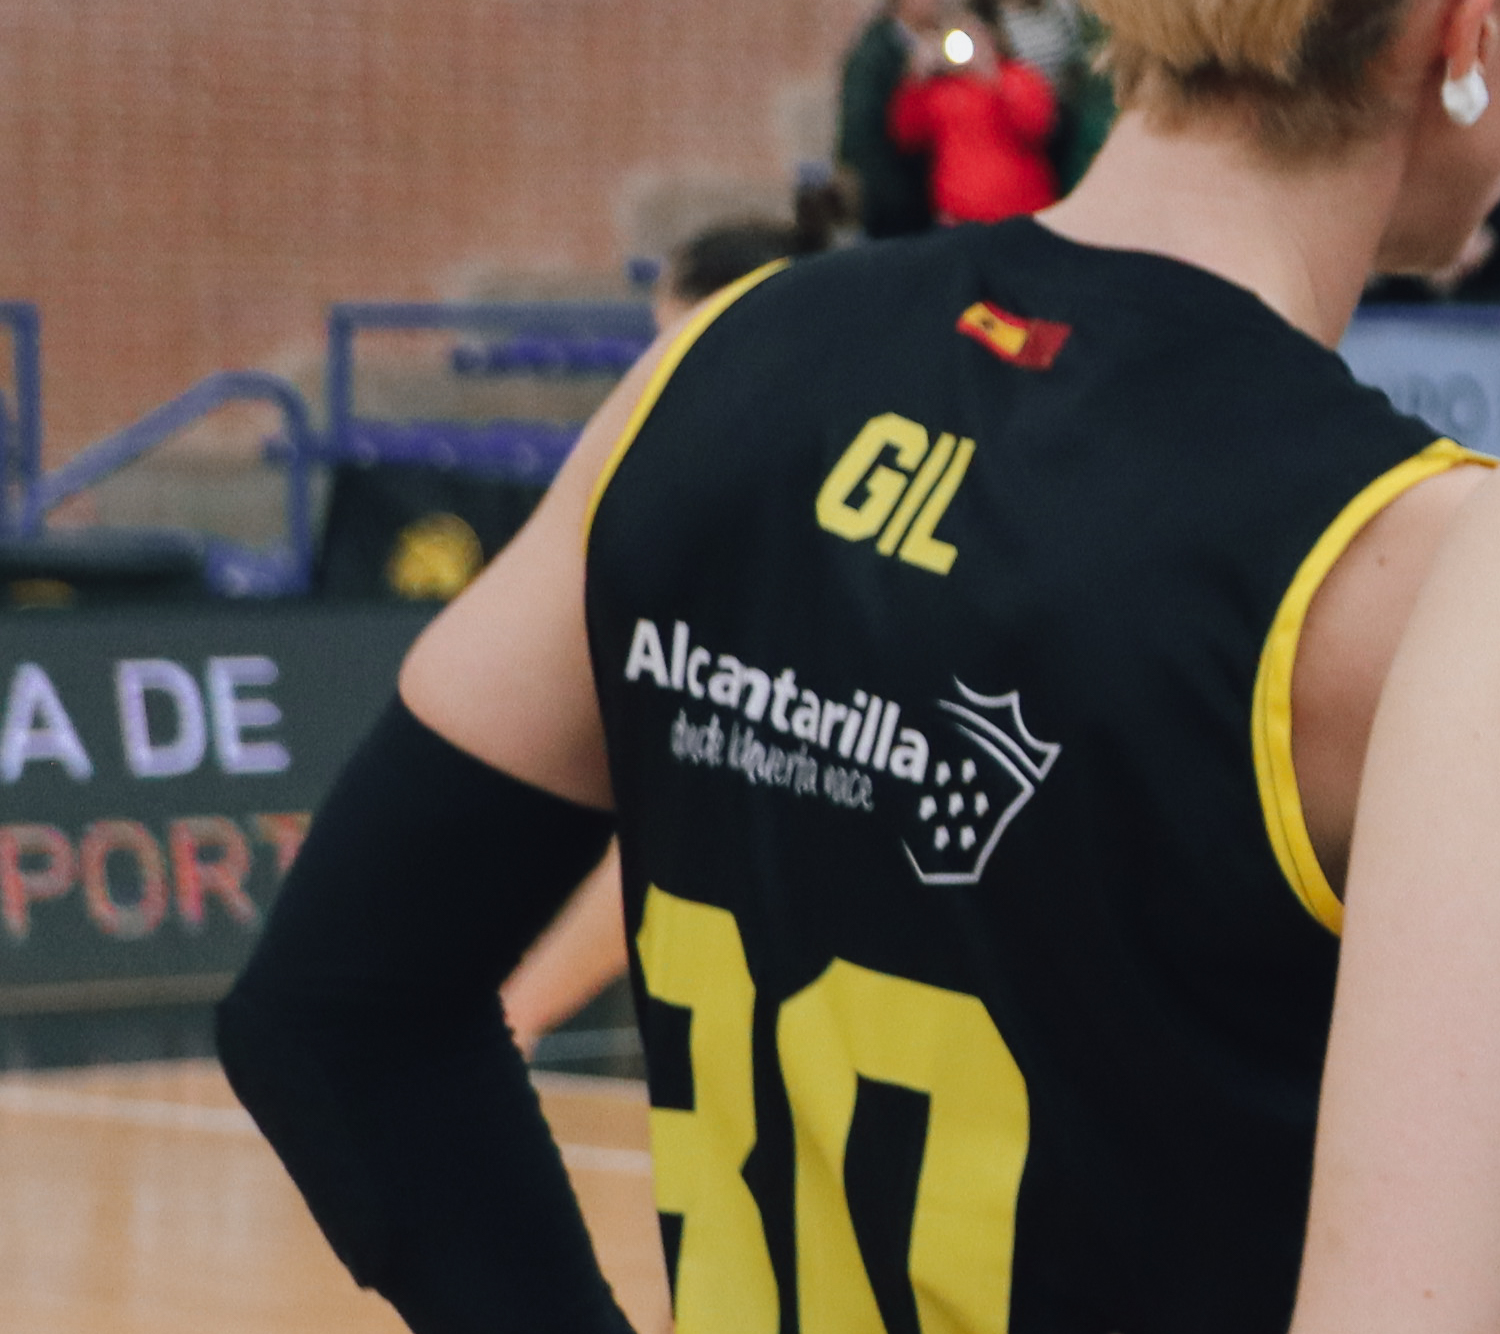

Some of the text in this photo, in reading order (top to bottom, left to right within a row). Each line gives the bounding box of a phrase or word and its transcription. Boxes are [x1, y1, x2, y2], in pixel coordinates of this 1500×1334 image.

[815, 412, 976, 576] GIL
[115, 654, 292, 779] DE
[624, 618, 930, 784] Alcantarilla
